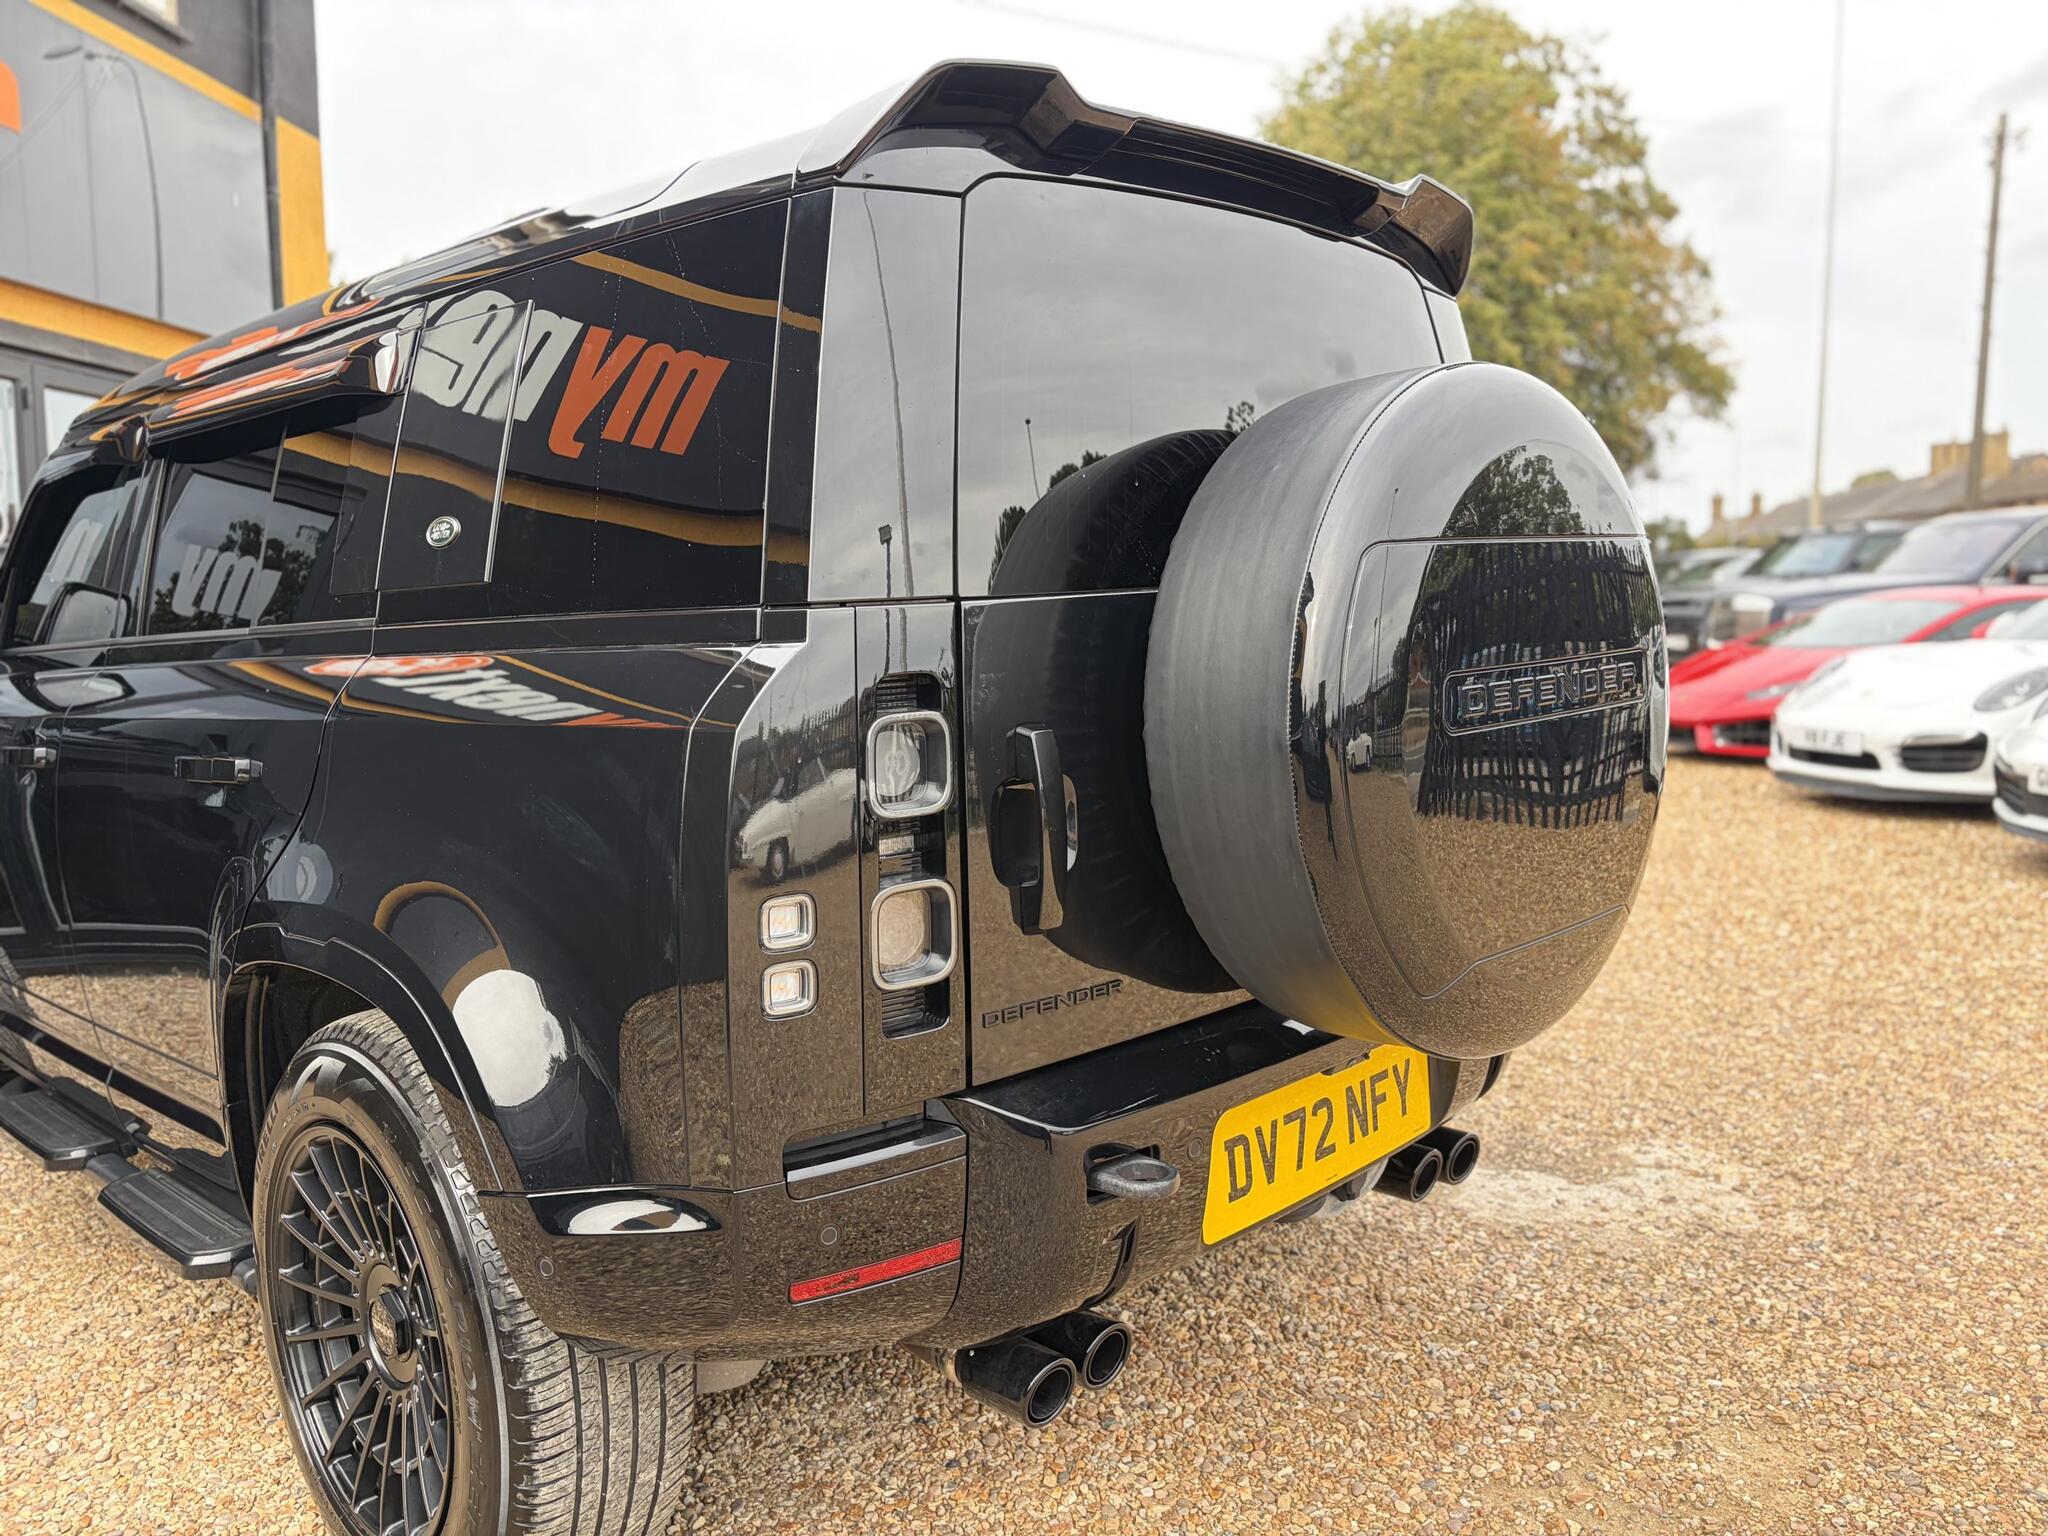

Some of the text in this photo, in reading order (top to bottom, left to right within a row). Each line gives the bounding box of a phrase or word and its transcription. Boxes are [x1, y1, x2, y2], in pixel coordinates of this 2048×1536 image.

[1458, 660, 1637, 718] DEFENDER
[982, 978, 1124, 1029] DEFENDER
[1223, 1057, 1411, 1205] DV72 NFY
